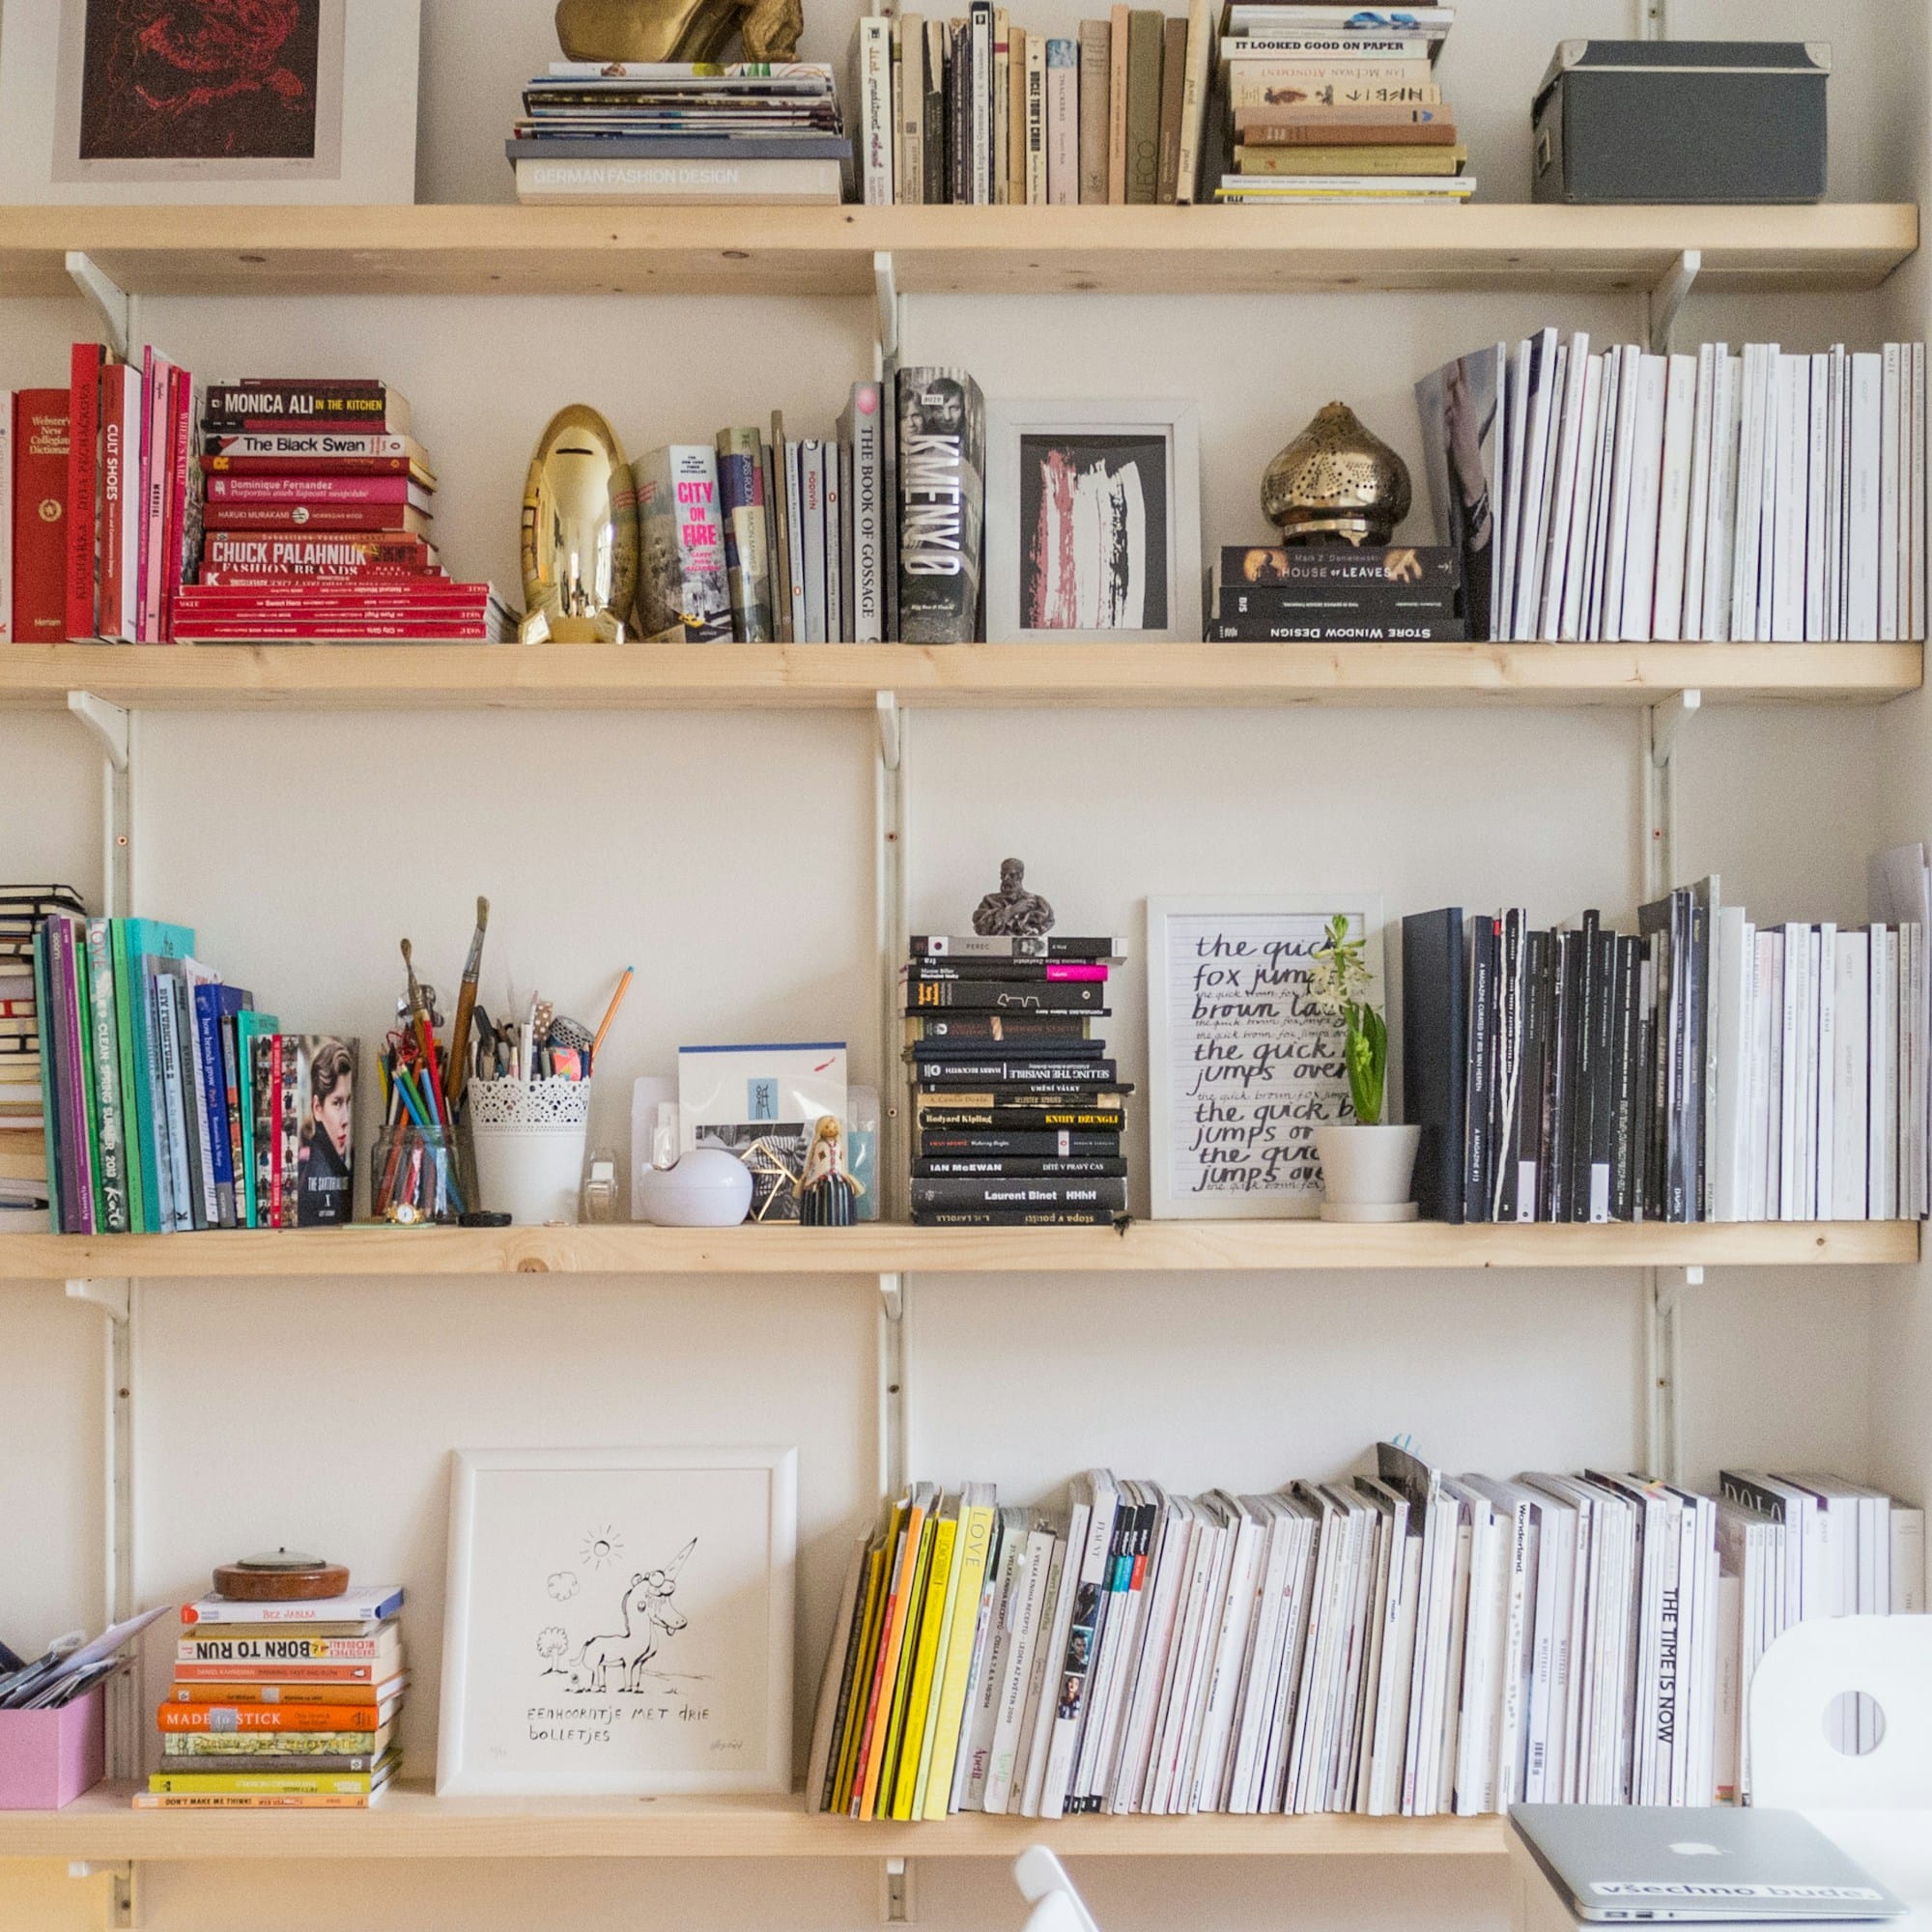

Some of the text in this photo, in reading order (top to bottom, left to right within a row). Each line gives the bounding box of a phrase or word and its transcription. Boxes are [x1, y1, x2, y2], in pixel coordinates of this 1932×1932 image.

[1236, 42, 1405, 50] IT LOOKED GOOD ON PAPER
[1031, 71, 1040, 97] UNCLE
[1031, 127, 1040, 152] CABIN
[535, 169, 738, 185] GERMAN FASHION DESIGN
[225, 394, 383, 414] MONICA ALI IN THE KITCHEN
[41, 426, 63, 436] New
[243, 437, 272, 451] The
[276, 437, 318, 451] Black
[323, 439, 365, 451] Swan
[107, 424, 119, 500] CULT SHOES
[231, 480, 333, 490] Dominique Fernandez
[678, 481, 713, 503] CITY
[905, 435, 960, 551] KMENY
[689, 507, 705, 521] ON
[861, 426, 874, 618] THE BOOK OF GOSSAGE
[682, 524, 717, 546] FIRE
[212, 542, 269, 562] CHUCK
[272, 542, 367, 566] PALAHNIUK
[222, 563, 359, 576] FASHION BRANDS
[1282, 567, 1392, 578] HOUSE LEAVES
[1270, 628, 1432, 639] STORE WINDOW DESIGN
[91, 920, 107, 970] LOVE
[1196, 933, 1258, 956] the
[1193, 963, 1241, 991] fox
[159, 988, 169, 1008] DIY
[1192, 993, 1281, 1019] brown
[201, 1017, 211, 1036] how
[1477, 1032, 1484, 1040] BY
[98, 1024, 113, 1059] CLEAN
[160, 1009, 174, 1071] FURNITURE
[204, 1037, 215, 1065] brands
[1194, 1037, 1335, 1074] the quick
[99, 1065, 113, 1103] SPRING
[205, 1065, 216, 1087] grow
[1009, 1069, 1110, 1079] SELLING THE INVISIBLE
[1187, 1065, 1275, 1096] jumps
[961, 1116, 992, 1124] Kipling
[1045, 1115, 1074, 1123] KNIHY
[1195, 1098, 1330, 1135] the quick
[1188, 1125, 1276, 1151] jumps
[1200, 1147, 1251, 1164] the
[1192, 1165, 1282, 1192] jumps
[103, 1186, 122, 1227] Kate
[985, 1191, 1096, 1201] Laurent Binet HHhH
[966, 1511, 988, 1568] LOVE
[1515, 1504, 1527, 1576] Wonderland.
[1031, 1554, 1040, 1577] VELKÁ
[1001, 1577, 1010, 1600] KNIHA
[1027, 1578, 1037, 1602] KNIHA
[196, 1640, 310, 1660] BORN TO RUN
[1016, 1641, 1026, 1665] LEDEN
[1658, 1587, 1679, 1745] THE TIME IS NOW
[1009, 1677, 1020, 1705] KVĚTEN
[166, 1714, 210, 1724] MADE
[236, 1714, 281, 1724] STICK
[632, 1708, 668, 1720] MET
[1602, 1883, 1756, 1897] všechno
